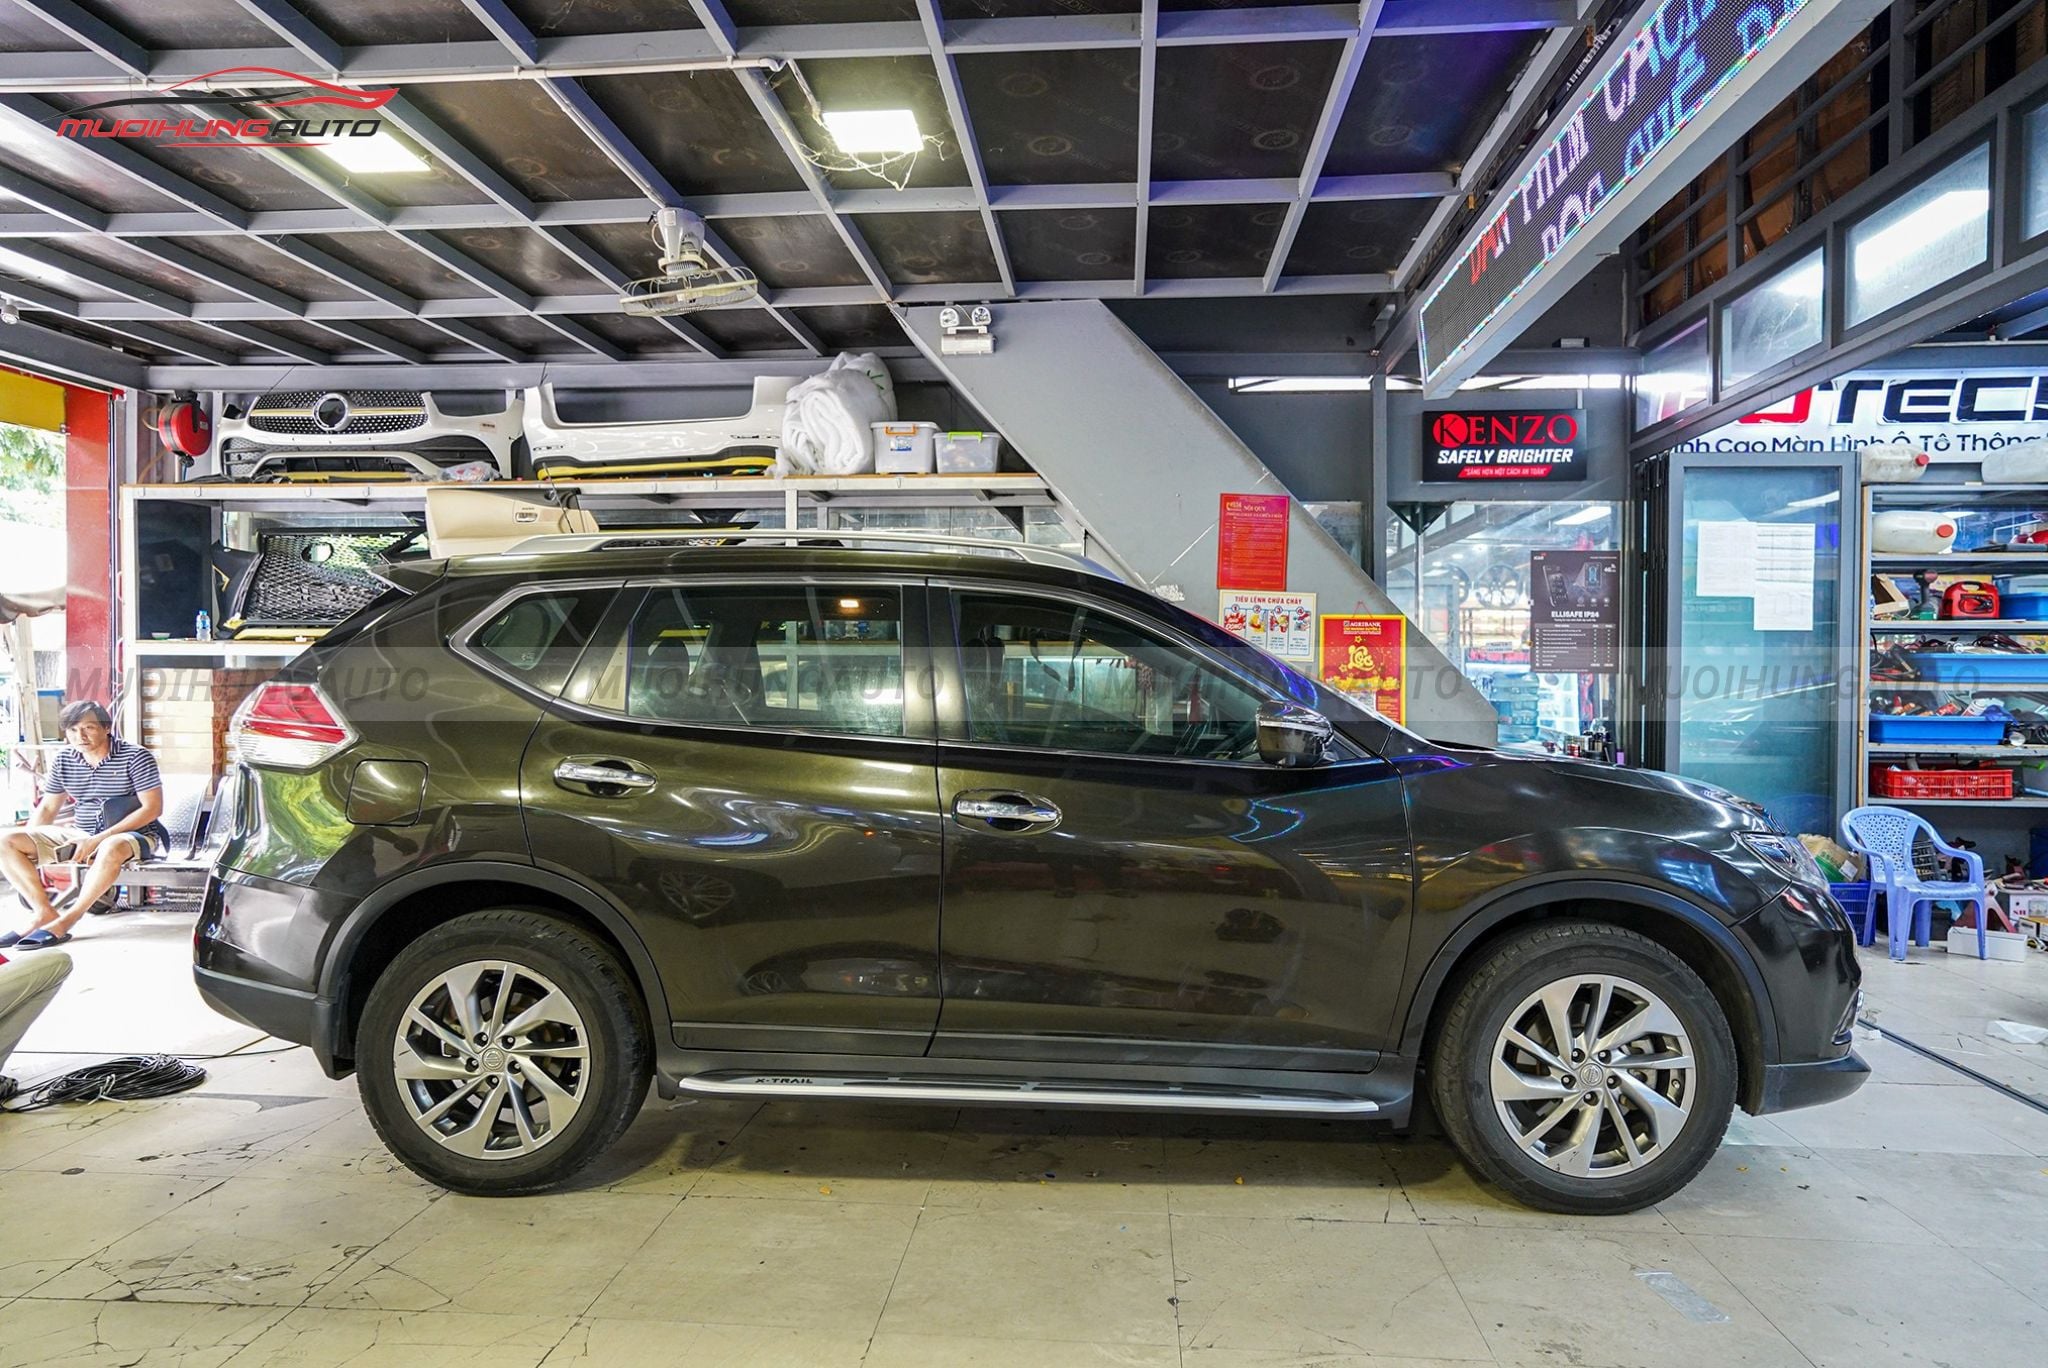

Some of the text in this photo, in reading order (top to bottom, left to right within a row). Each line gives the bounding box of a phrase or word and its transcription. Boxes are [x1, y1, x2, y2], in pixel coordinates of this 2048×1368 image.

[1433, 413, 1579, 449] KENZO
[1715, 438, 1767, 453] Cao
[1772, 435, 1824, 452] Màn
[1919, 433, 1951, 452] Tô
[1956, 432, 2041, 451] Thôn
[1438, 448, 1574, 464] SAFELY BRIGHTER
